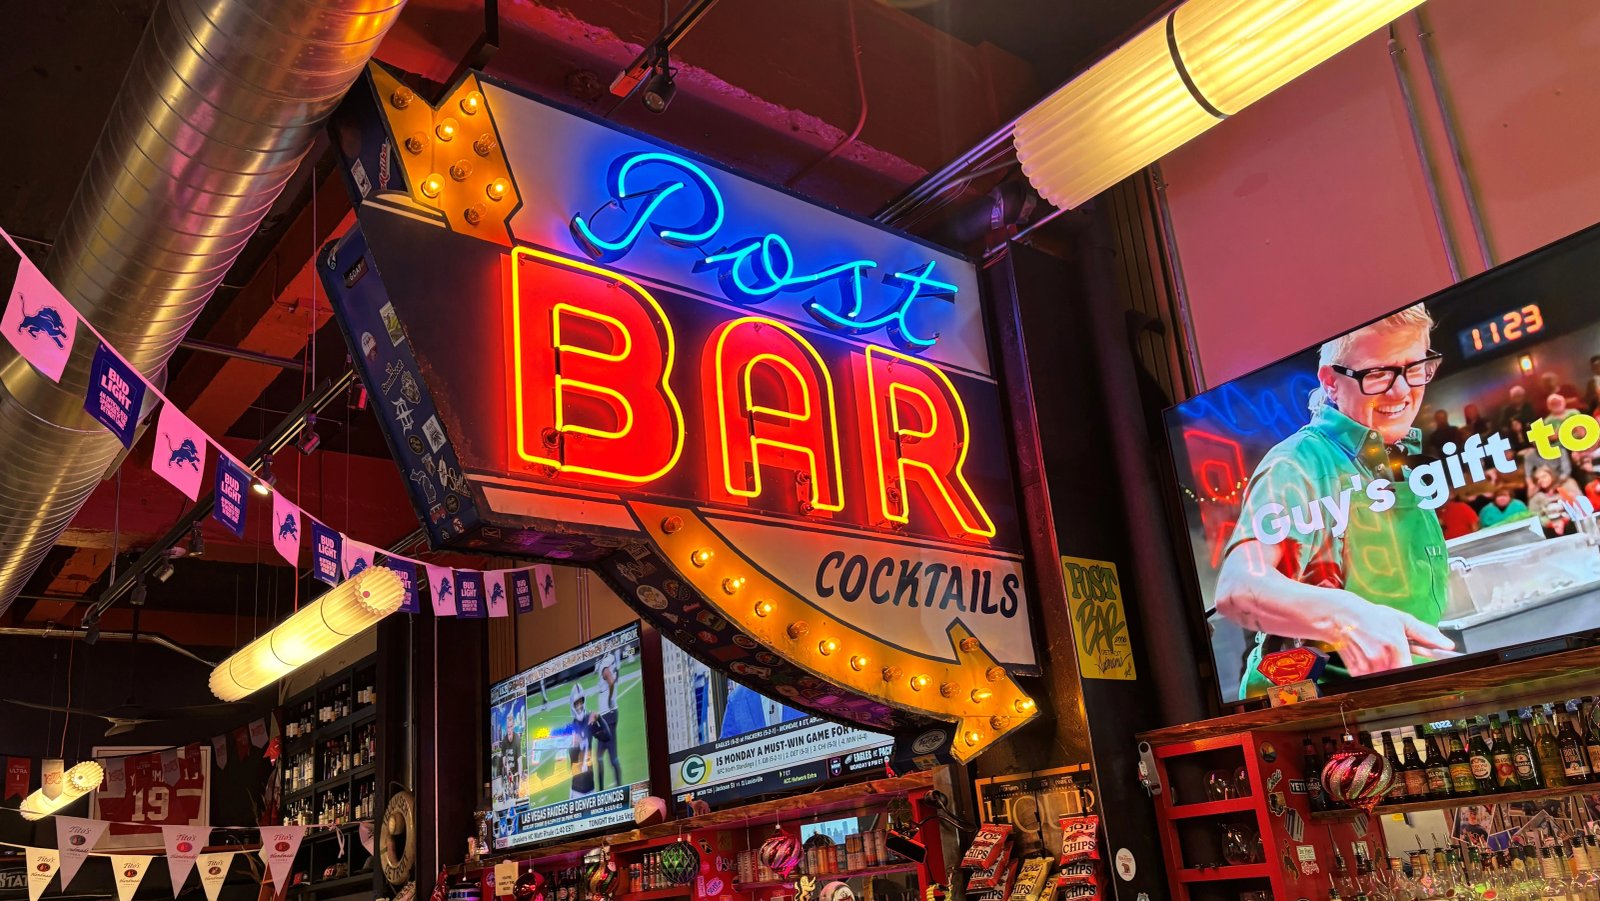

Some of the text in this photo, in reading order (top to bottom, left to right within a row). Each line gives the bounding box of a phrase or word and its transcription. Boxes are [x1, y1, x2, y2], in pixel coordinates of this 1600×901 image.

[570, 150, 960, 350] Post
[1471, 303, 1546, 351] 1123
[108, 367, 130, 396] BUD
[101, 374, 132, 412] LIGHT
[505, 245, 998, 541] BAR
[224, 472, 240, 491] BUD
[1251, 474, 1396, 545] Guy's
[1408, 433, 1518, 511] gift
[1527, 413, 1600, 460] to
[221, 480, 242, 505] LIGHT
[320, 534, 335, 549] BUD
[318, 543, 337, 559] LIGHT
[463, 581, 475, 590] BUD
[815, 550, 1020, 618] COCKTAILS
[1065, 562, 1118, 602] POST
[461, 588, 477, 597] LIGHT
[716, 725, 849, 767] IS MONDAY A MUST-WIN GAME FOR
[853, 750, 872, 763] EAGLES
[790, 774, 807, 782] Network
[807, 772, 818, 780] Extra
[1290, 781, 1307, 791] YETI
[131, 786, 170, 822] 19
[521, 812, 531, 824] LAS
[531, 808, 547, 822] VEGAS
[547, 803, 569, 820] RAIDERS
[575, 796, 597, 812] DENVER
[597, 789, 625, 806] BRONCOS
[588, 816, 608, 828] TONIGHT
[608, 816, 616, 824] the
[616, 814, 625, 822] Las
[1066, 822, 1095, 833] JOE
[69, 826, 92, 835] Tito's
[176, 833, 197, 842] Tito's
[273, 833, 294, 841] Tito's
[1063, 841, 1096, 854] CHIPS
[37, 855, 56, 863] Tito's
[207, 859, 225, 867] Tito's
[1061, 863, 1093, 876] CHIPS
[1065, 884, 1097, 899] CHIPS
